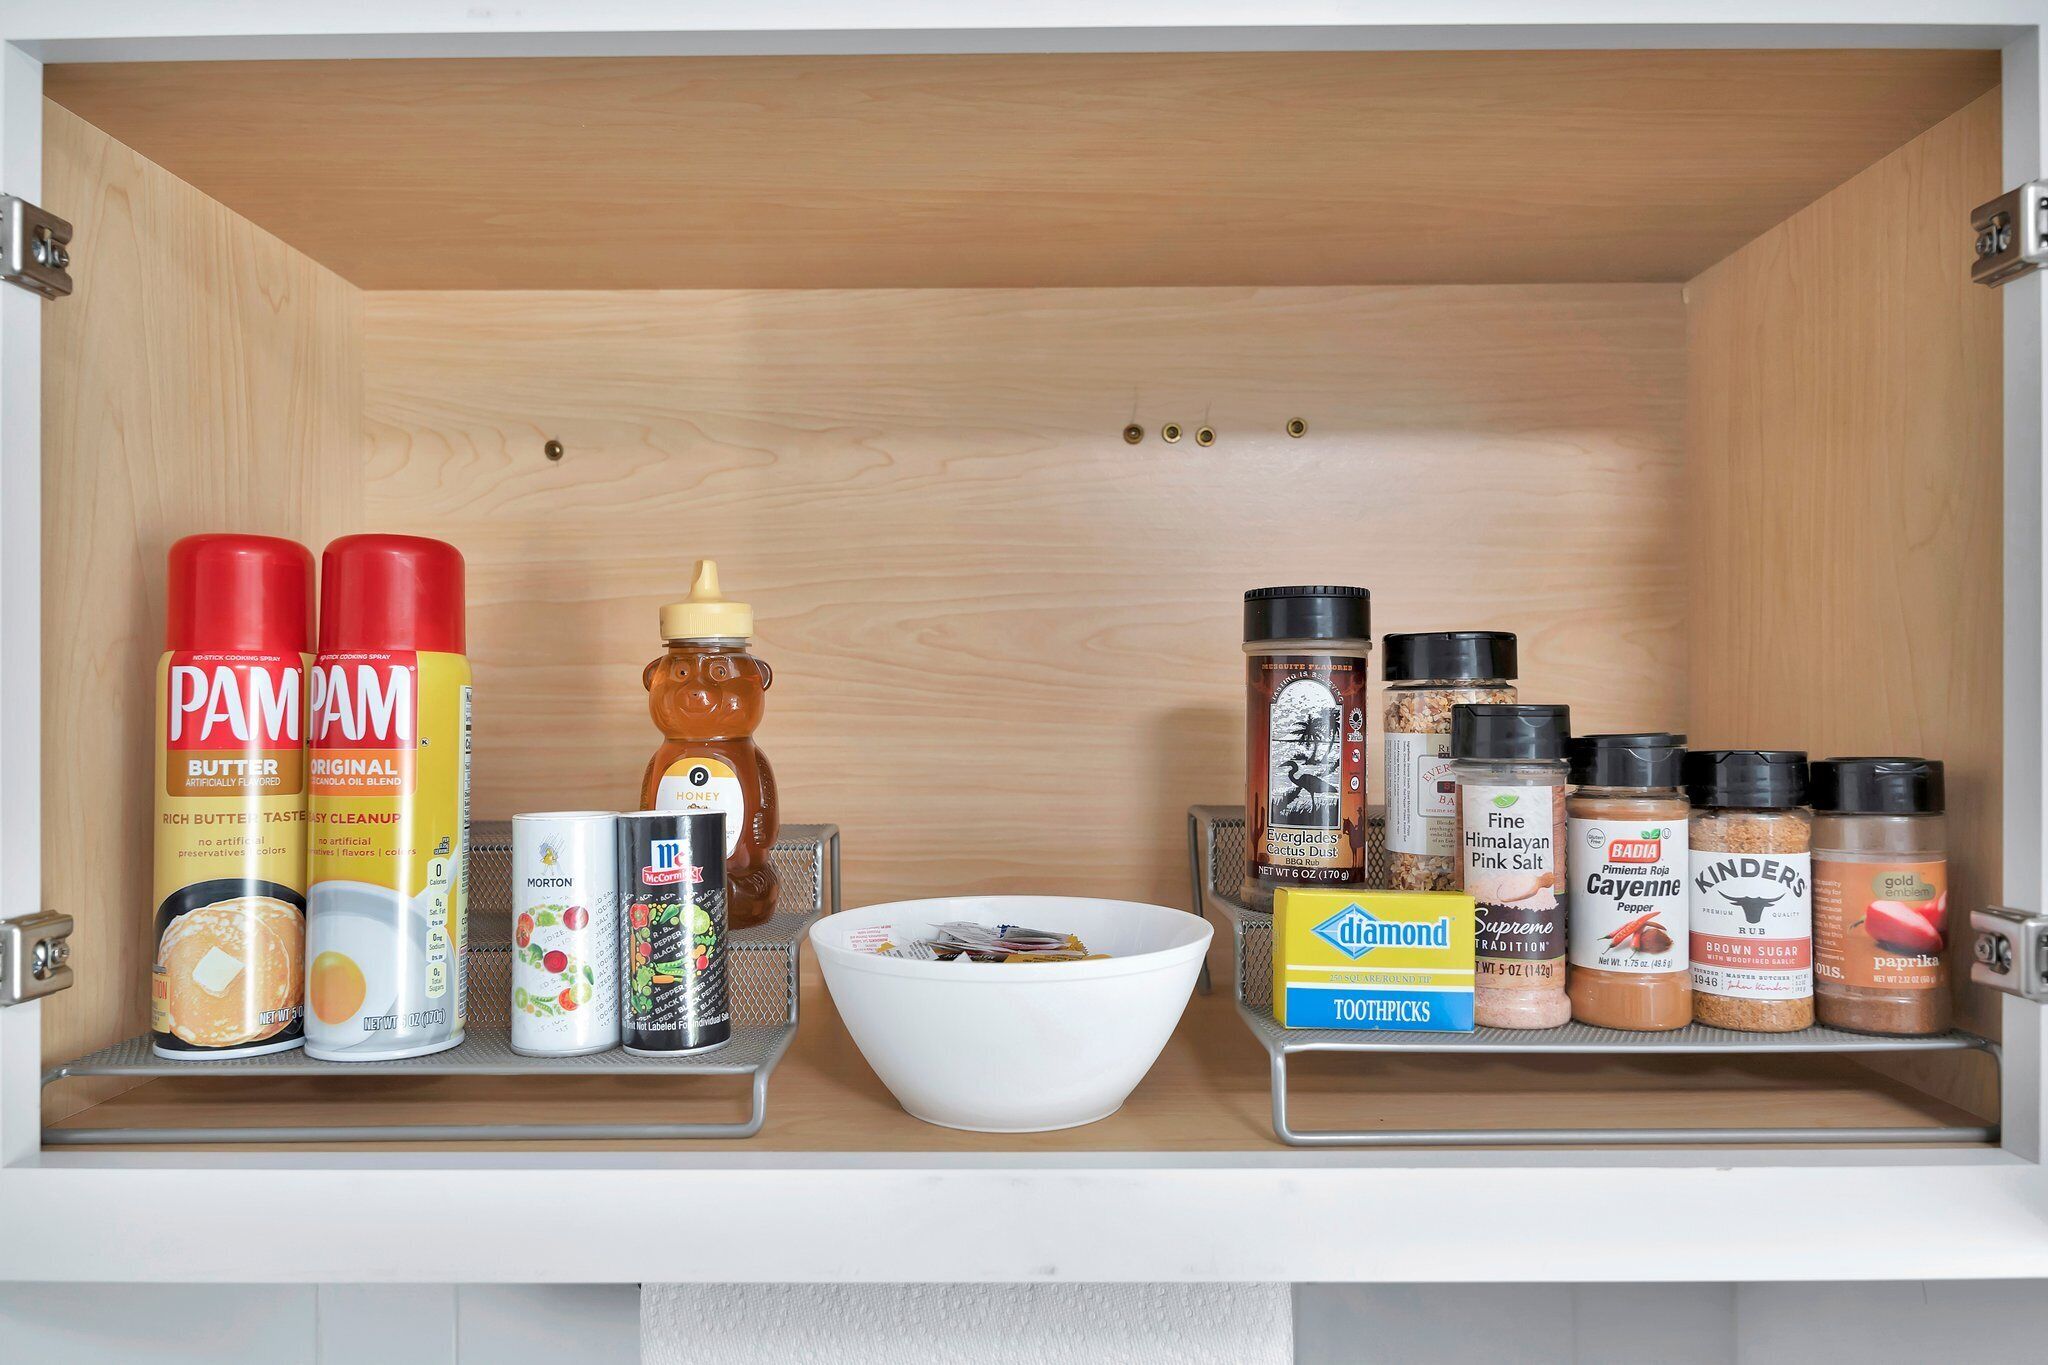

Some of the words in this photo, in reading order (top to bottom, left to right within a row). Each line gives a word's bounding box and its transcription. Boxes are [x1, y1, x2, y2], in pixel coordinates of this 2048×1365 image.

[1308, 663, 1353, 671] FLAVORED
[171, 666, 299, 741] PAM
[310, 665, 411, 741] PAM
[188, 759, 278, 776] BUTTER
[310, 759, 398, 775] ORIGINAL
[185, 777, 236, 787] ARTIFICIALLY
[238, 777, 281, 787] FLAVORED
[348, 777, 365, 786] OIL
[366, 777, 401, 786] BLEND
[676, 791, 720, 801] HONEY
[162, 813, 189, 825] RICH
[264, 810, 306, 823] TASTE
[330, 813, 402, 824] CLEANUP
[1488, 812, 1525, 829] Fine
[198, 838, 212, 846] no
[216, 836, 265, 846] artificial
[329, 837, 371, 845] artificial
[1267, 828, 1338, 846] Everglades
[1465, 831, 1550, 854] Himalayan
[178, 849, 245, 859] preservatives
[256, 847, 286, 856] colors
[342, 848, 375, 857] flavors
[385, 848, 416, 856] colors
[1266, 843, 1306, 857] Cactus
[1309, 846, 1338, 858] Dust
[1611, 843, 1658, 858] BADIA
[1285, 858, 1304, 866] BBQ
[1305, 858, 1320, 866] Rub
[1472, 852, 1508, 870] Pink
[1512, 853, 1543, 870] Salt
[436, 863, 442, 877] 0
[645, 869, 697, 883] McCormick
[1258, 865, 1274, 876] NET
[1275, 868, 1290, 878] WT
[1291, 869, 1299, 878] 6
[1301, 869, 1317, 879] OZ
[1318, 870, 1340, 880] (170
[1340, 870, 1350, 880] g)
[1601, 864, 1647, 875] Pimienta
[1650, 865, 1670, 879] Roja
[527, 877, 573, 888] MORTON
[1694, 858, 1806, 898] KINDER'S
[1885, 875, 1914, 889] gold
[1587, 873, 1681, 901] Cayenne
[1885, 888, 1931, 897] emblem
[1617, 902, 1654, 914] Pepper
[1702, 907, 1734, 916] PREMIUM
[1474, 907, 1554, 941] Supreme
[1738, 926, 1766, 935] RUB
[1340, 916, 1448, 947] diamond
[653, 930, 682, 949] PEPPER
[1475, 939, 1547, 952] TRADITION
[653, 944, 677, 960] BLACK
[1706, 941, 1751, 956] BROWN
[1758, 946, 1798, 956] SUGAR
[1599, 957, 1610, 965] Net
[1611, 957, 1622, 967] Wt.
[1624, 958, 1639, 968] 1.75
[1640, 960, 1650, 968] oz.
[1707, 953, 1724, 961] WITH
[1726, 956, 1770, 966] WOODFIRED
[1873, 955, 1940, 971] paprika
[1481, 961, 1496, 975] WT
[1499, 964, 1505, 975] 5
[1508, 965, 1521, 976] OZ
[1525, 963, 1554, 978] (142g)
[1694, 967, 1719, 976] FOUNDED
[1725, 972, 1757, 980] MASTER
[1758, 973, 1790, 981] BUTCHER
[1329, 974, 1342, 983] 250
[1418, 975, 1432, 984] TIP
[1694, 974, 1718, 987] 1946
[1755, 980, 1791, 991] Kinder
[1873, 975, 1886, 983] NET
[1887, 975, 1897, 984] WT
[1898, 975, 1911, 984] 2.12
[1911, 975, 1920, 984] OZ
[655, 984, 685, 1003] PEPPER
[654, 997, 680, 1014] BLACK
[700, 992, 720, 1011] BLACK
[258, 1010, 275, 1025] NET
[277, 1008, 290, 1023] WT
[291, 1007, 298, 1021] 5
[1333, 999, 1431, 1023] TOOTHPICKS
[363, 1015, 381, 1031] NET
[383, 1014, 397, 1030] WT
[409, 1012, 420, 1027] OZ
[422, 1007, 446, 1029] (170g)
[636, 1021, 647, 1031] Not
[648, 1020, 677, 1031] Labeled
